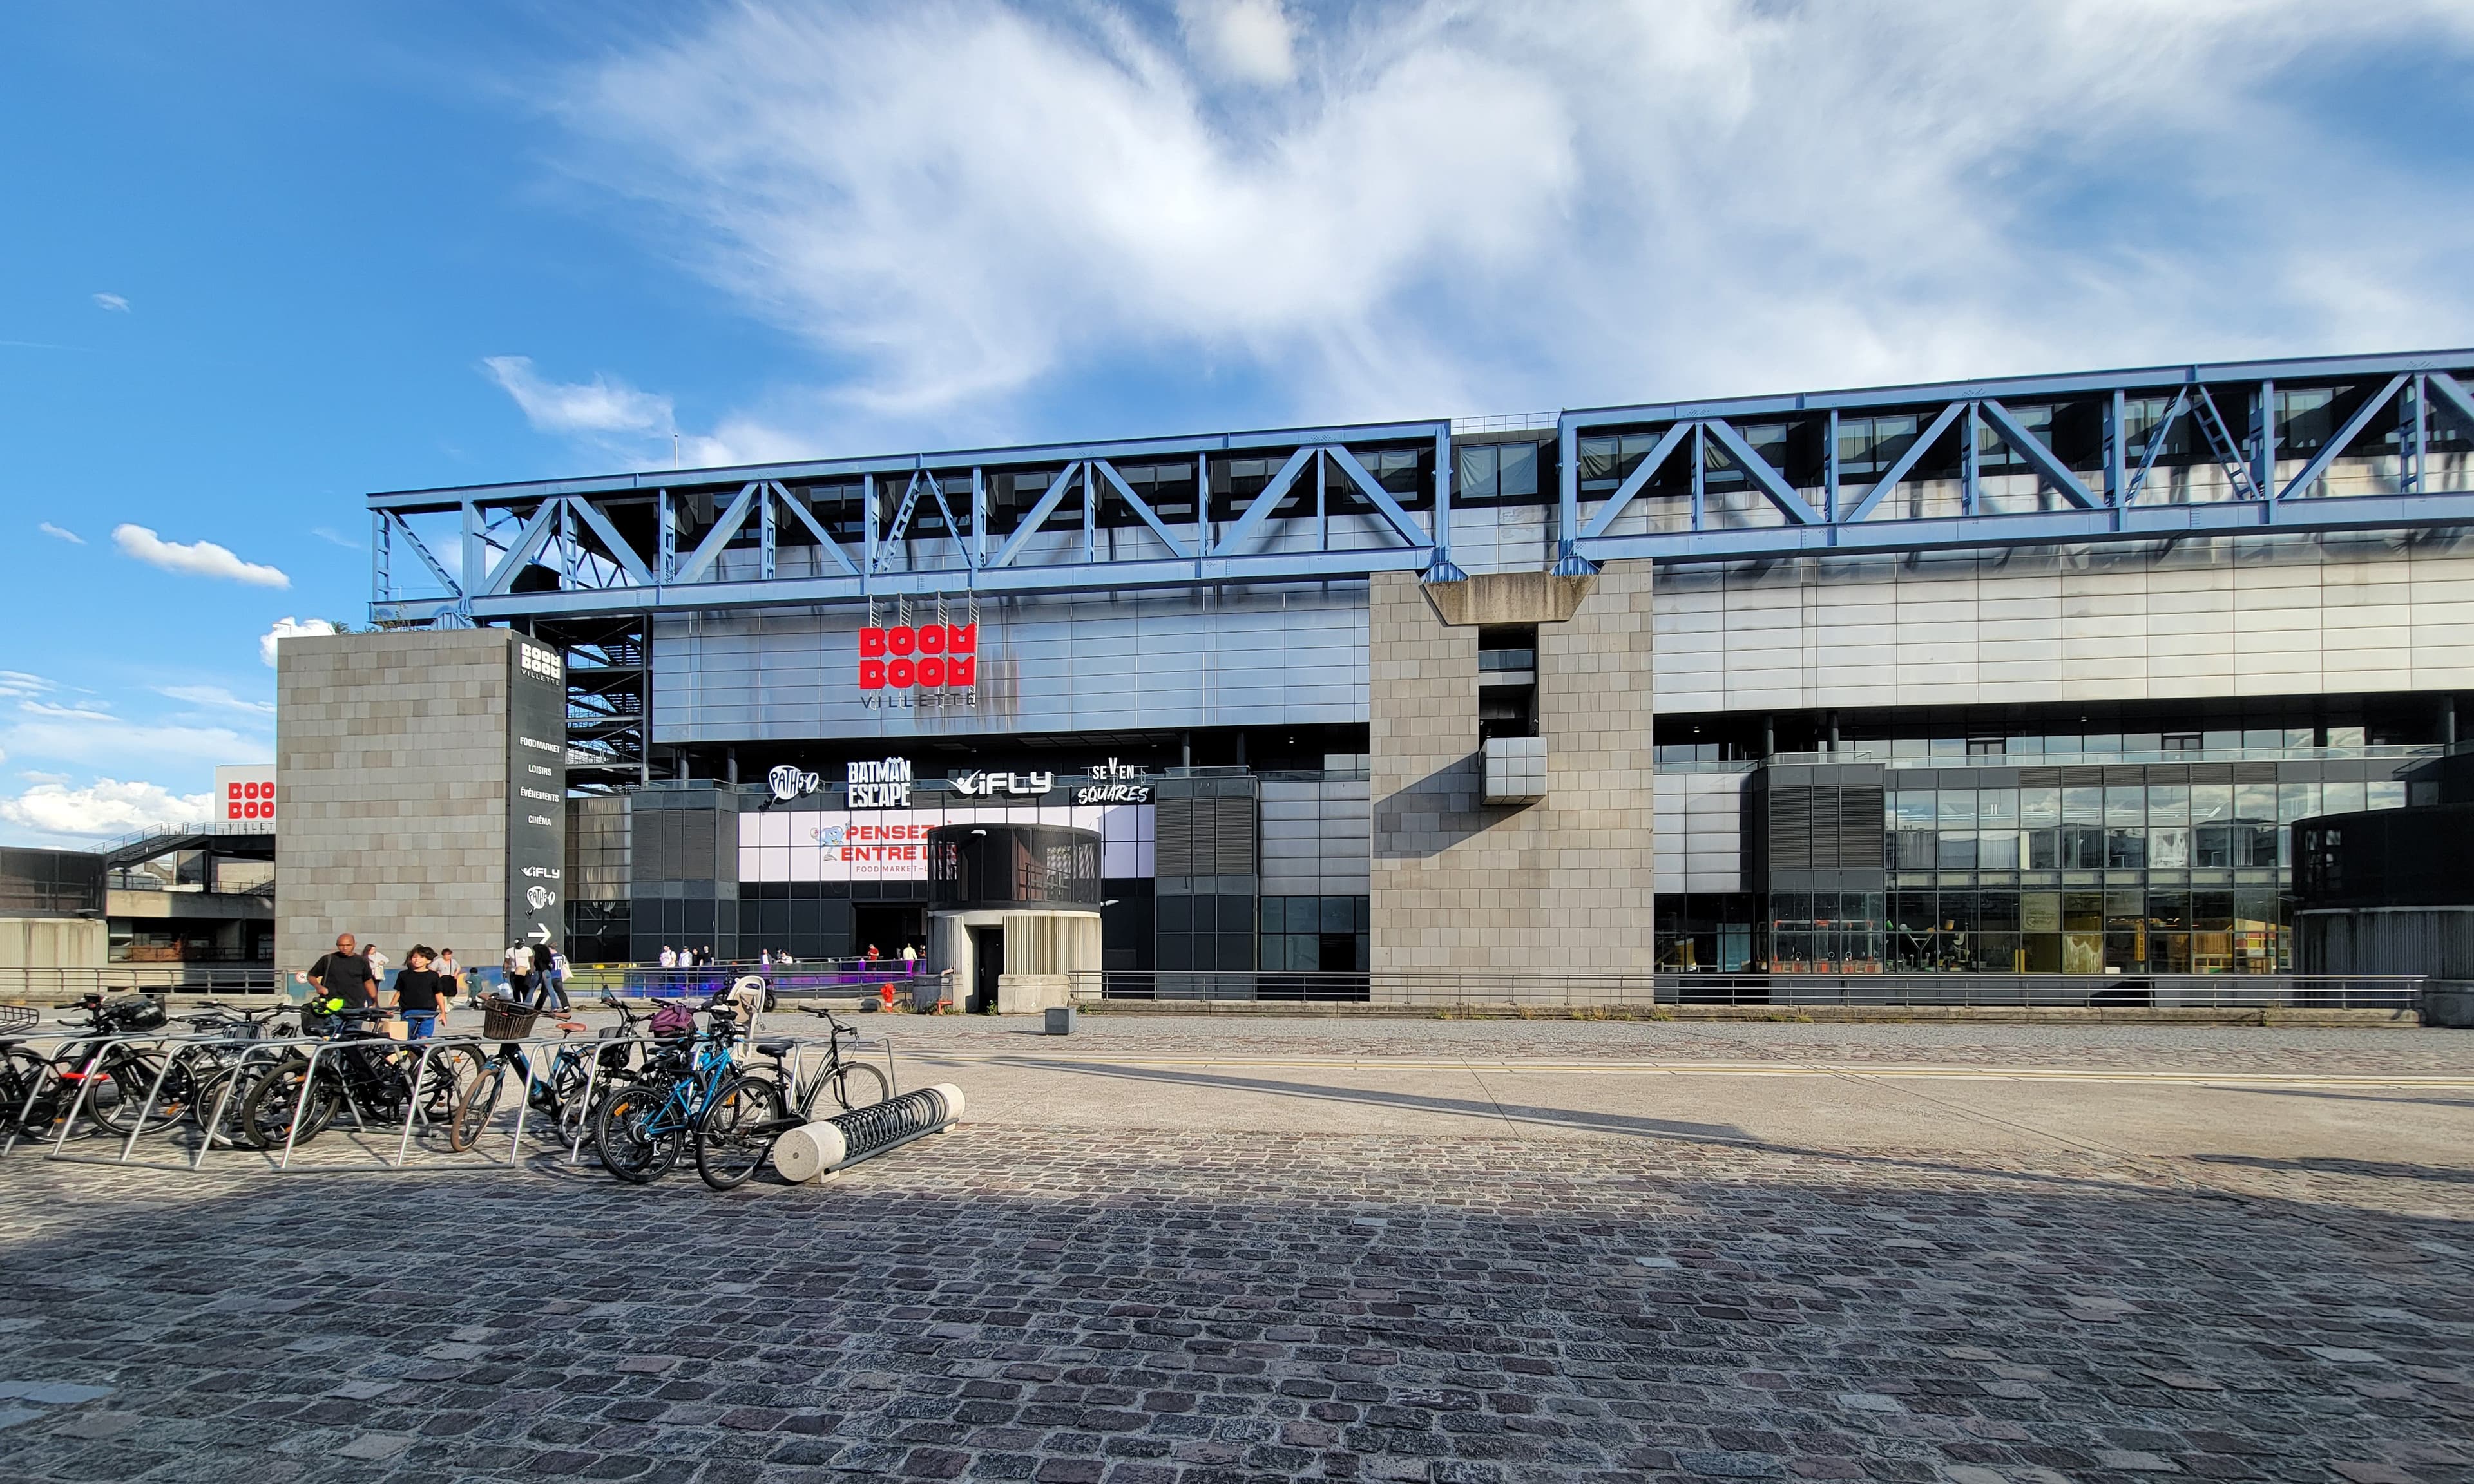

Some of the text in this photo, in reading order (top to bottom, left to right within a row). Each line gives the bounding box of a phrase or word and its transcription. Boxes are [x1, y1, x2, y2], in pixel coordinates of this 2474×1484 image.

[859, 623, 976, 657] BOOM
[521, 643, 561, 667] BOOM
[521, 655, 561, 680] BOOM
[859, 656, 975, 689] BOOM
[521, 669, 561, 686] VILLETTE
[860, 693, 975, 709] VILLETTE
[519, 736, 561, 754] FOODMARKET
[528, 764, 552, 777] LOISIRS
[847, 760, 912, 783] BATMAN
[520, 786, 560, 803] ÉVÉNEMENTS
[848, 783, 912, 808] ESCAPE
[1077, 783, 1149, 804] SQUARES
[528, 815, 552, 826] CINÉMA
[840, 846, 917, 861] ENTRE
[554, 959, 563, 971] 10
